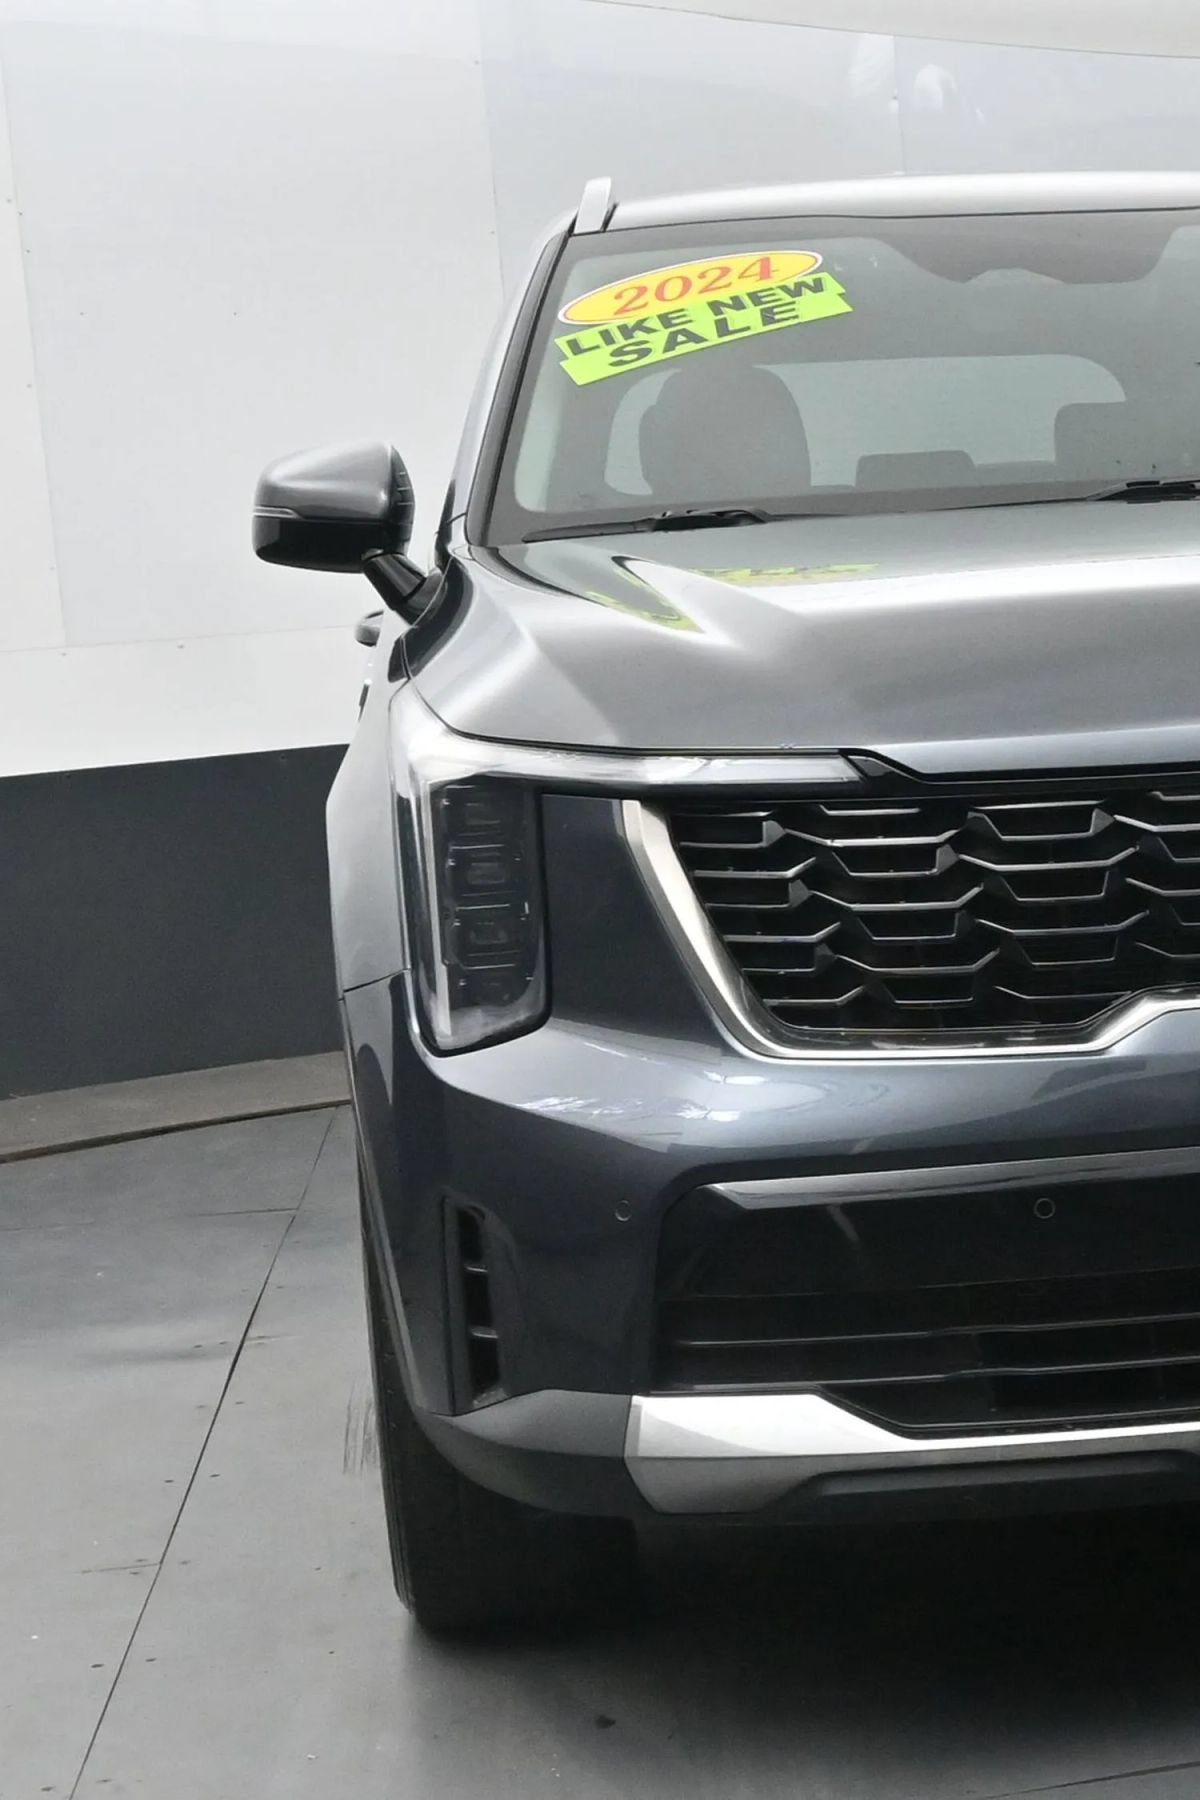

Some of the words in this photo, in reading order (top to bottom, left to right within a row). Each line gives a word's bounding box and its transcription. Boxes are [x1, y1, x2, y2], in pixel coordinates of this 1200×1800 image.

[566, 308, 696, 356] LIKE
[707, 277, 826, 316] NEW
[613, 256, 778, 316] 2024
[608, 300, 800, 367] SALE
